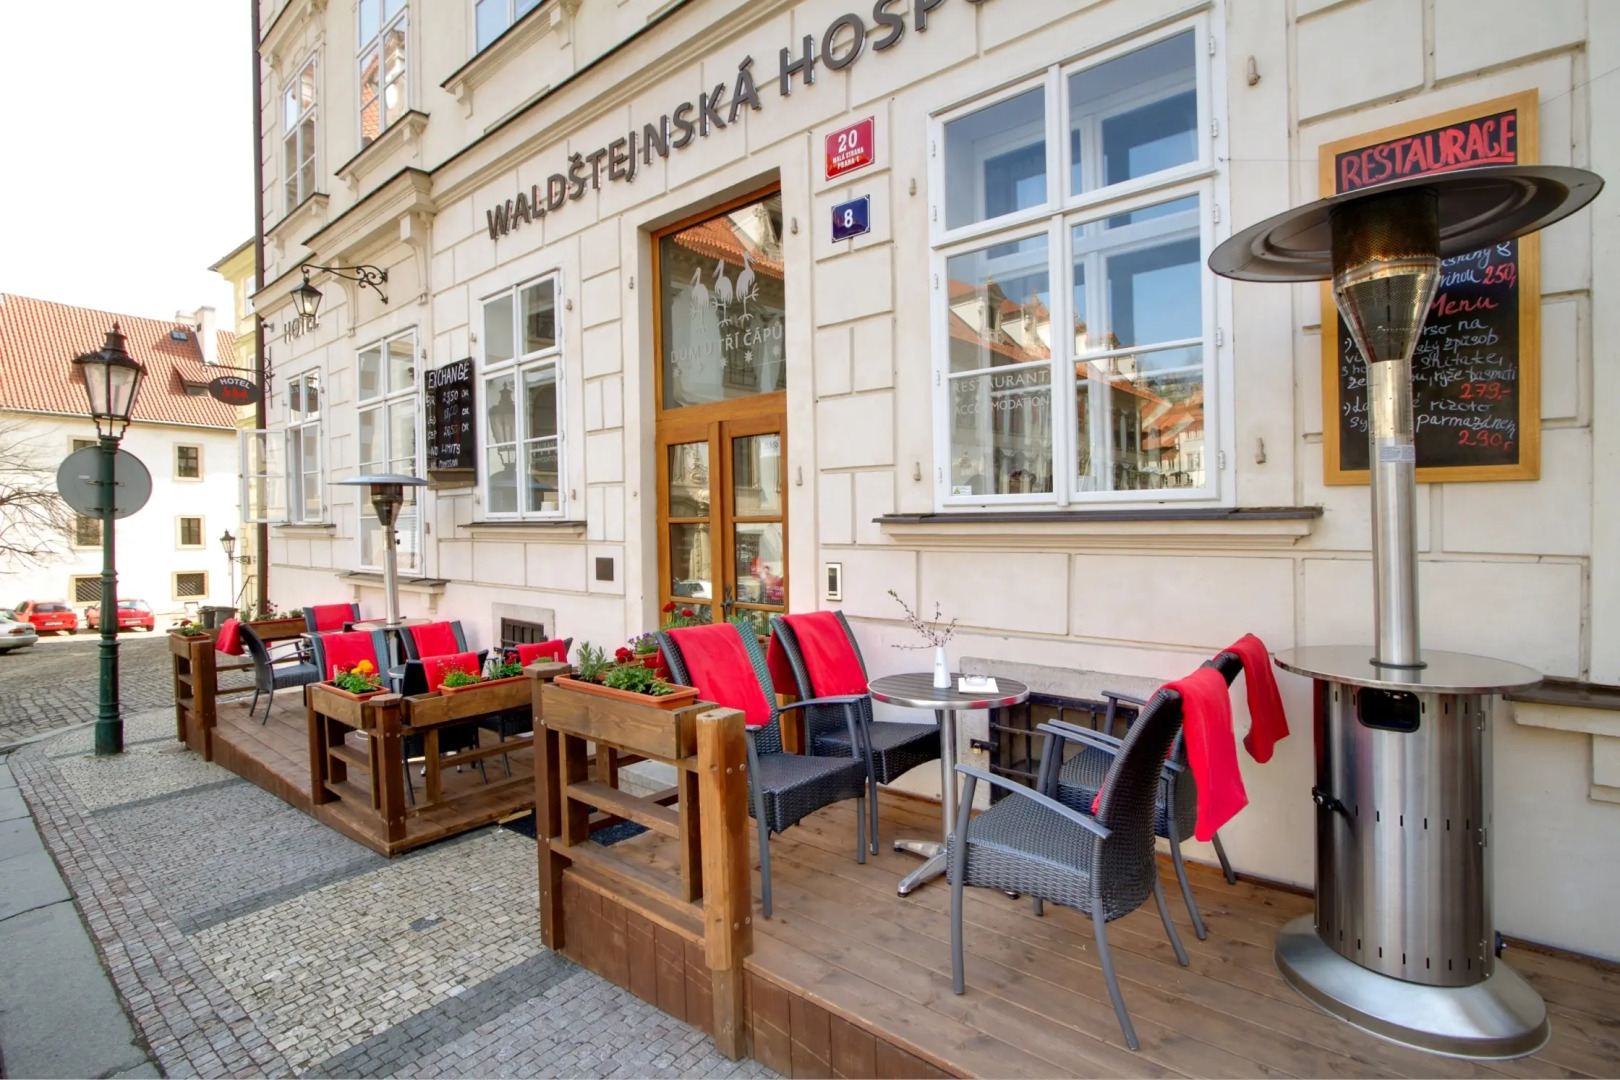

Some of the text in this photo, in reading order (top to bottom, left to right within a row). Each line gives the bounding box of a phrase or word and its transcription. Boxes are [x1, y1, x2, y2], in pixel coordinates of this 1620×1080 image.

[486, 0, 984, 241] WALDŠTEJNSKÁ HOSP
[838, 129, 858, 154] 20
[1341, 114, 1516, 191] RESTAURACE
[844, 209, 854, 228] 8
[1430, 292, 1499, 317] Menu
[284, 315, 320, 345] HOTEL
[743, 321, 783, 346] ČÁPŮ
[1423, 319, 1489, 336] rso na
[220, 378, 251, 390] HOTEL
[428, 361, 470, 389] EXCHANGE
[953, 370, 1048, 393] RESURANT
[954, 396, 1050, 415] ACCOMODATION
[1430, 398, 1494, 412] rizoto
[441, 443, 461, 455] LIMITS
